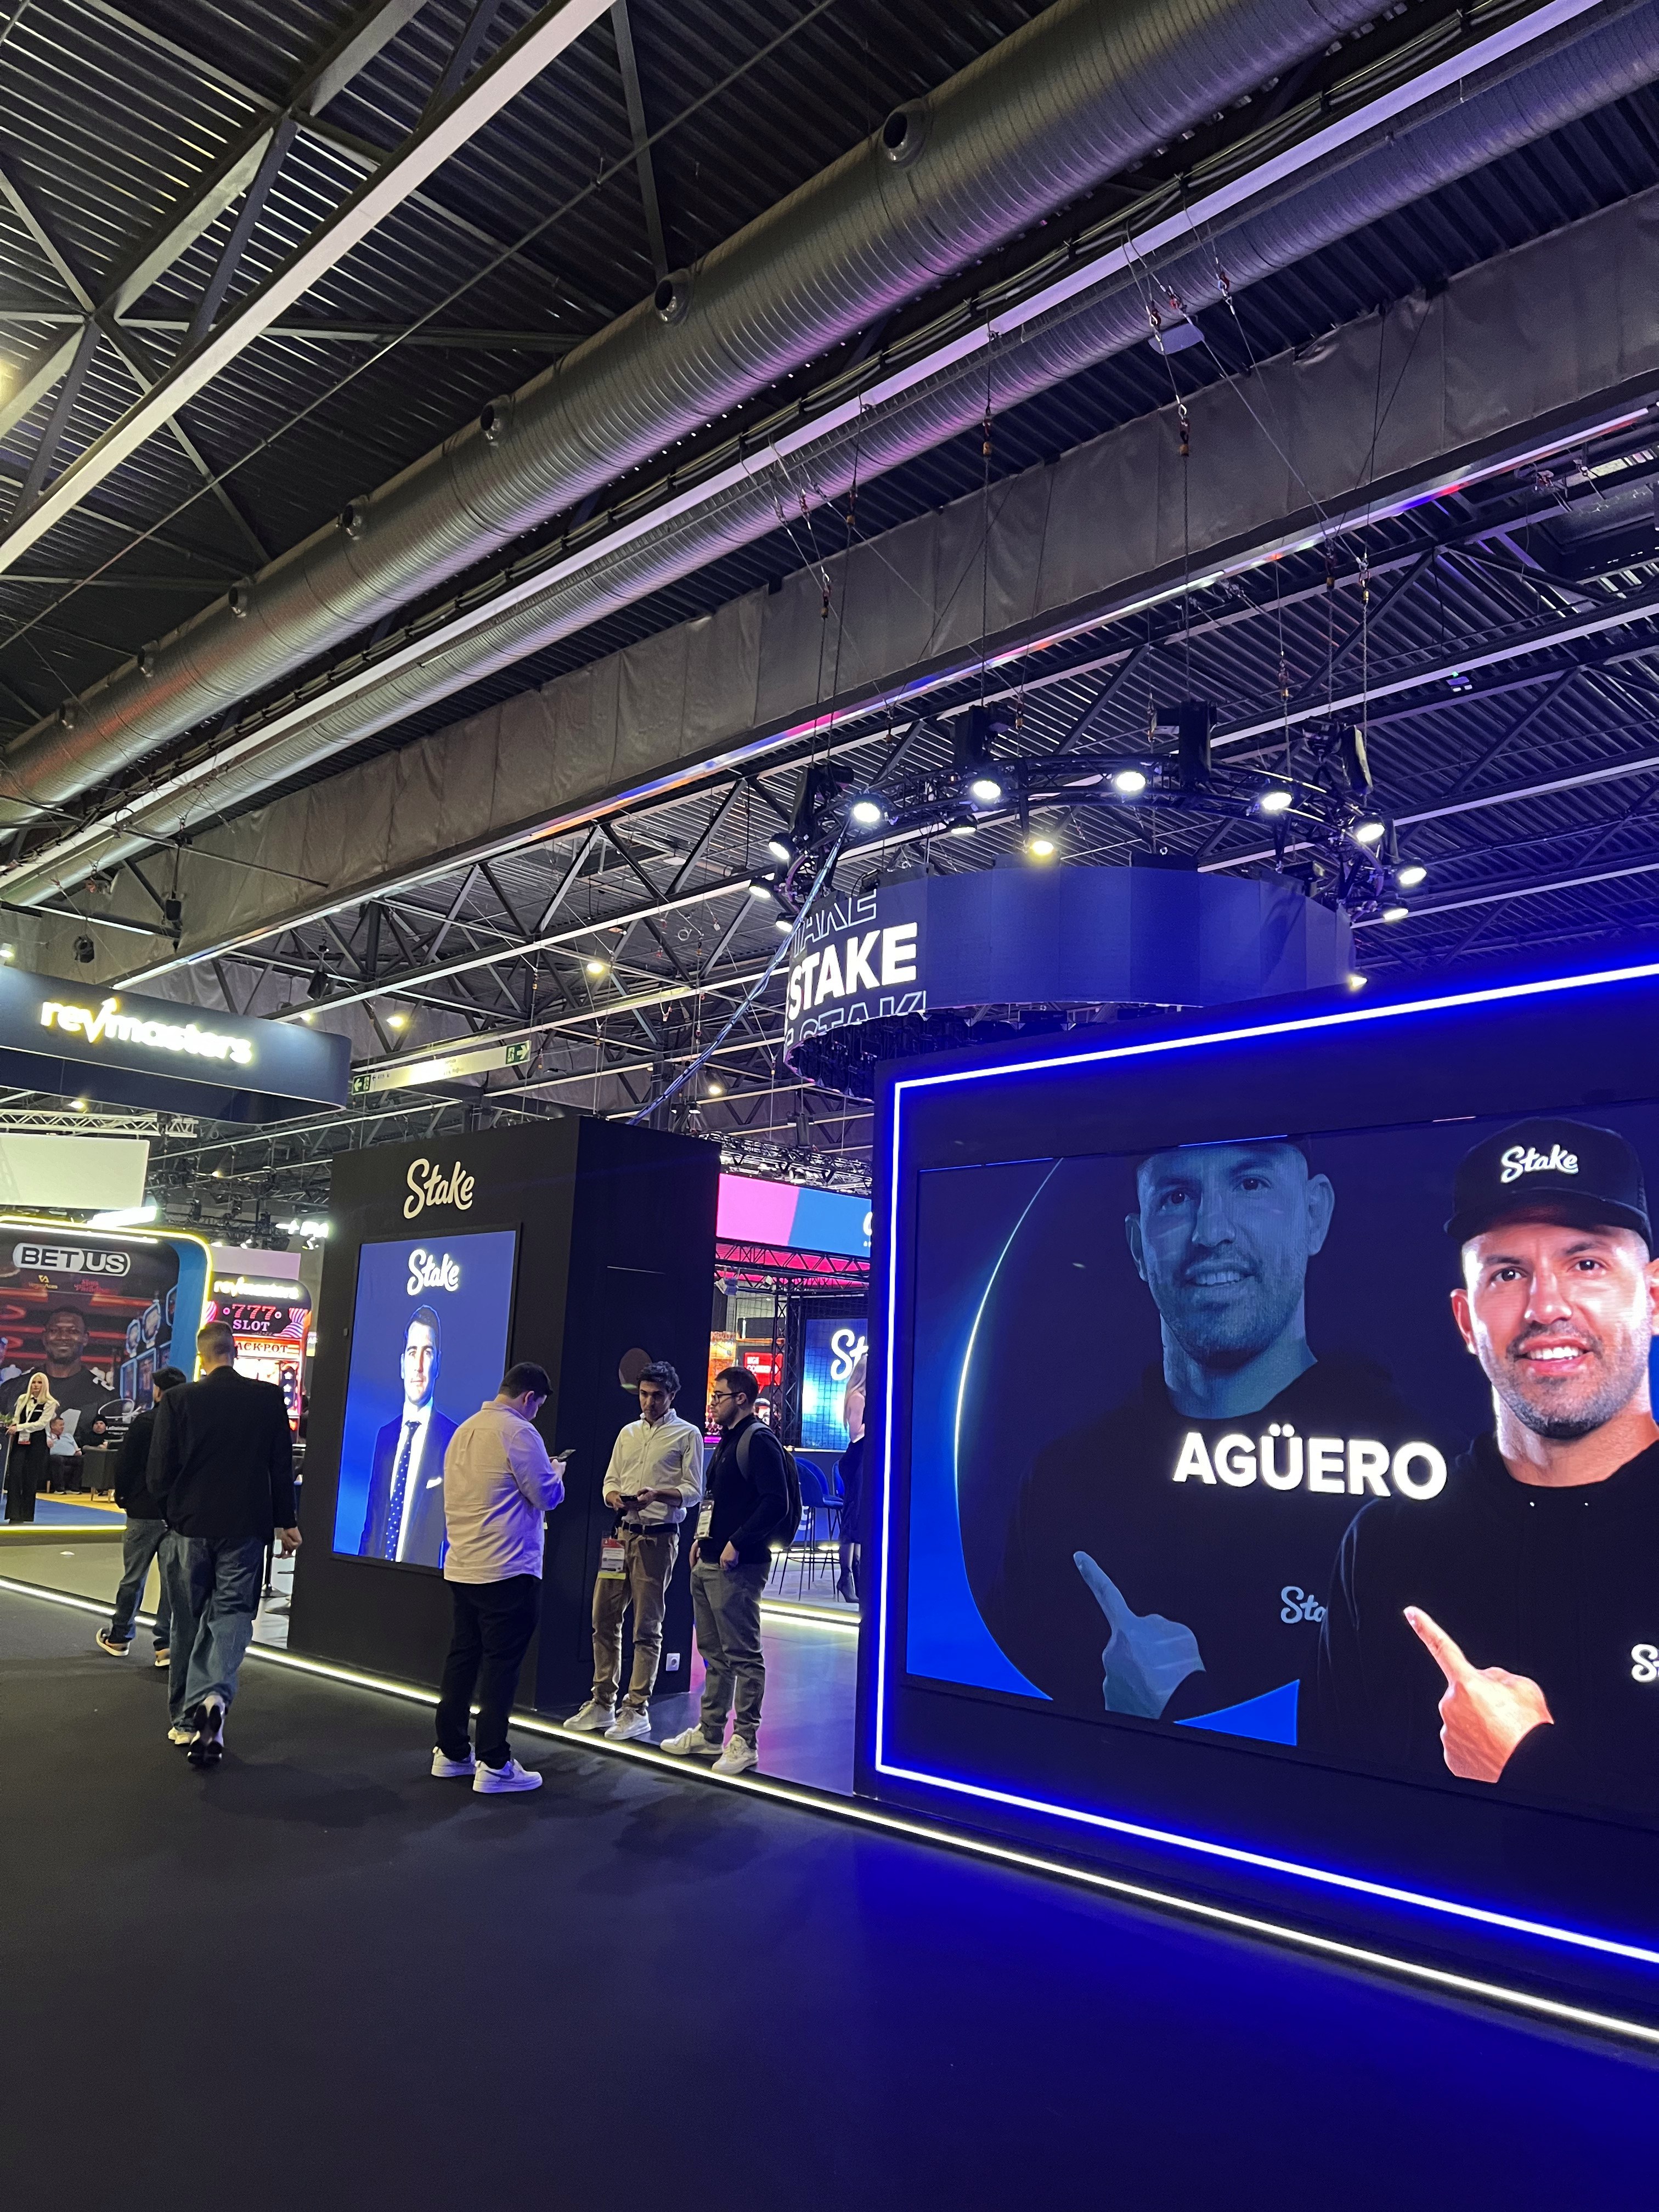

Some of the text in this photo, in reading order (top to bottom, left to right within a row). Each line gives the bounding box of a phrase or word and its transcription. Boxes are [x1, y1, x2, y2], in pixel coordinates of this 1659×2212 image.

[789, 922, 918, 1021] STAKE
[1500, 1144, 1579, 1183] Stake
[403, 1158, 475, 1219] Stake
[407, 1249, 460, 1296] Stake
[232, 1304, 276, 1321] 777
[233, 1319, 270, 1331] SLOT
[236, 1342, 288, 1353] ACKPOT
[1172, 1423, 1447, 1500] AGÜERO
[1281, 1586, 1326, 1624] Sta
